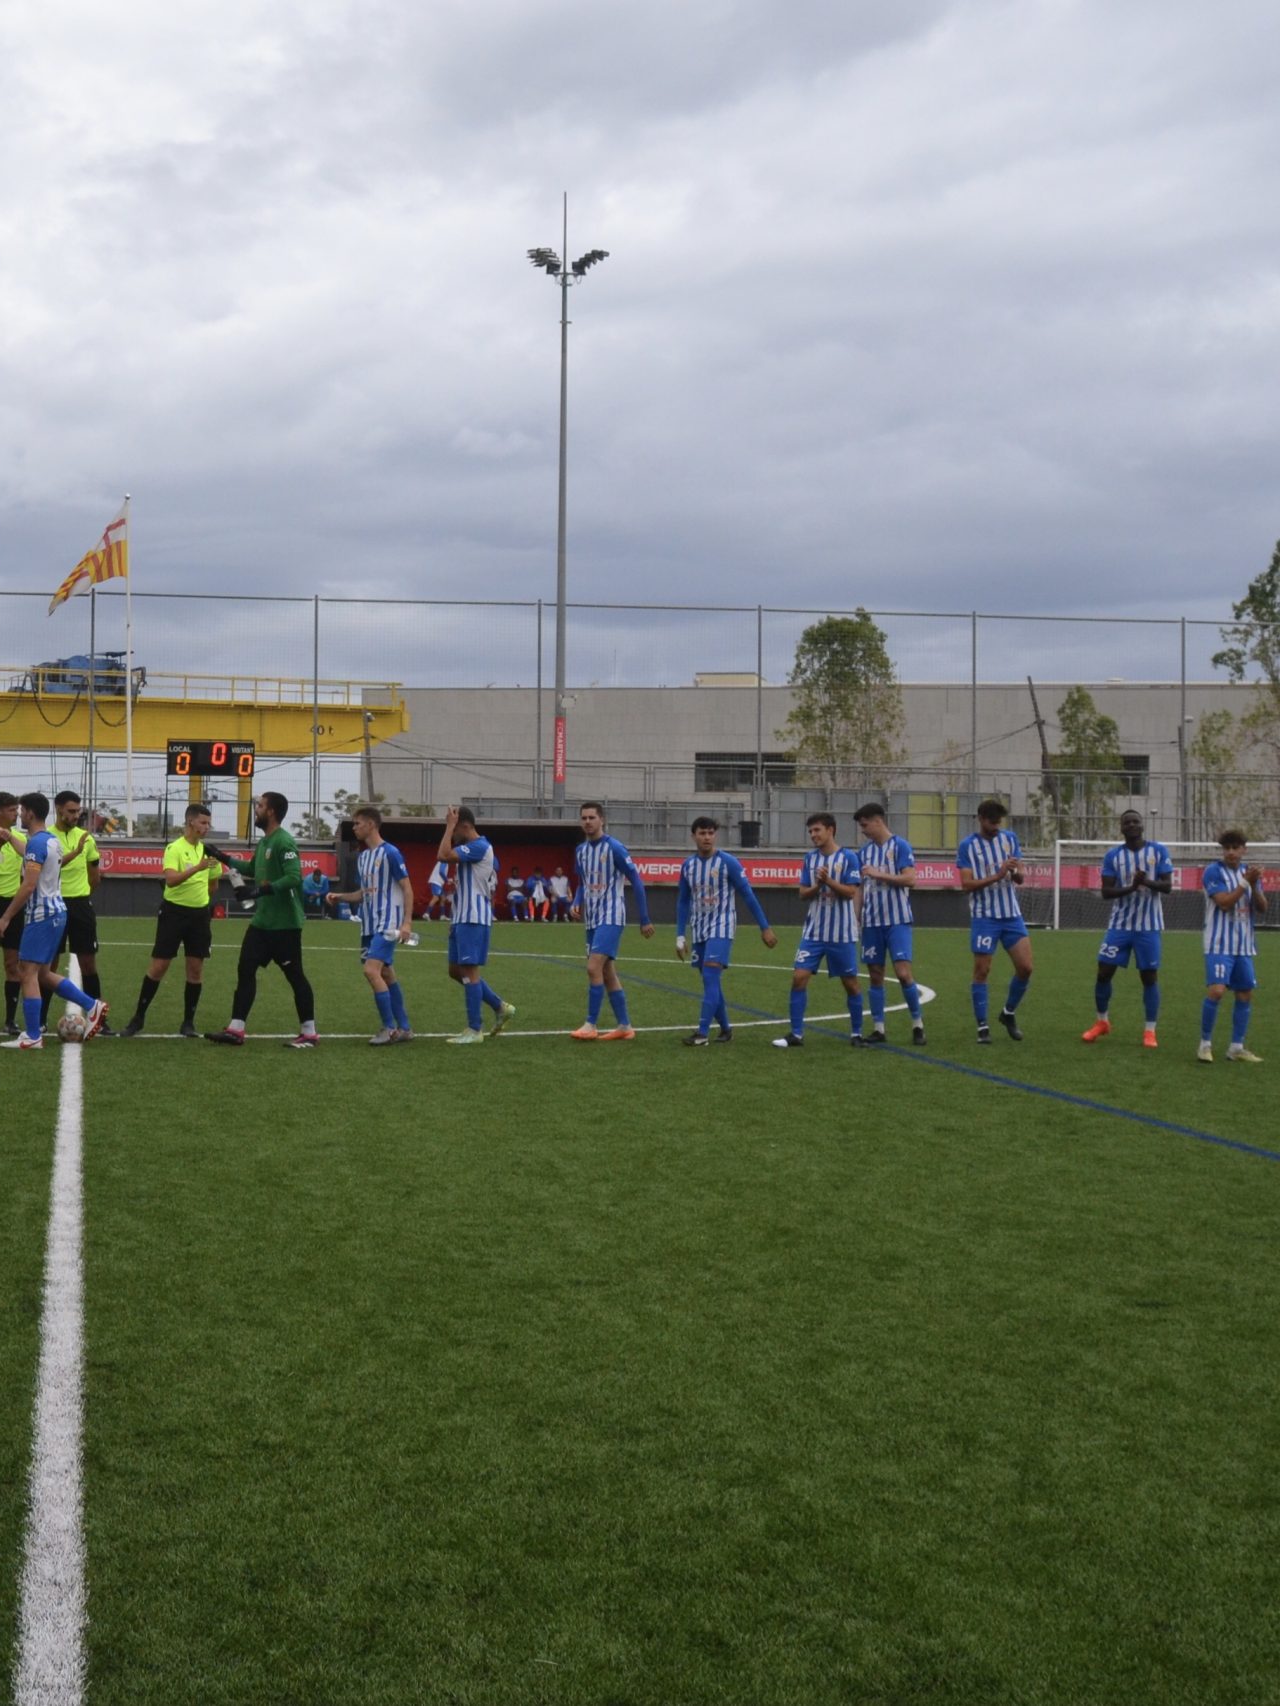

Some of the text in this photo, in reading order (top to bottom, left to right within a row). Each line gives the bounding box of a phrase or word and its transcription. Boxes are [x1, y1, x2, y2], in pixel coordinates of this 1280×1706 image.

[169, 745, 192, 753] LOCAL
[211, 742, 227, 766] 0
[176, 752, 191, 775] 0
[238, 754, 253, 776] 0
[914, 866, 954, 879] aBank
[976, 935, 992, 949] 19
[1099, 943, 1119, 958] 23
[1214, 964, 1225, 978] 11
